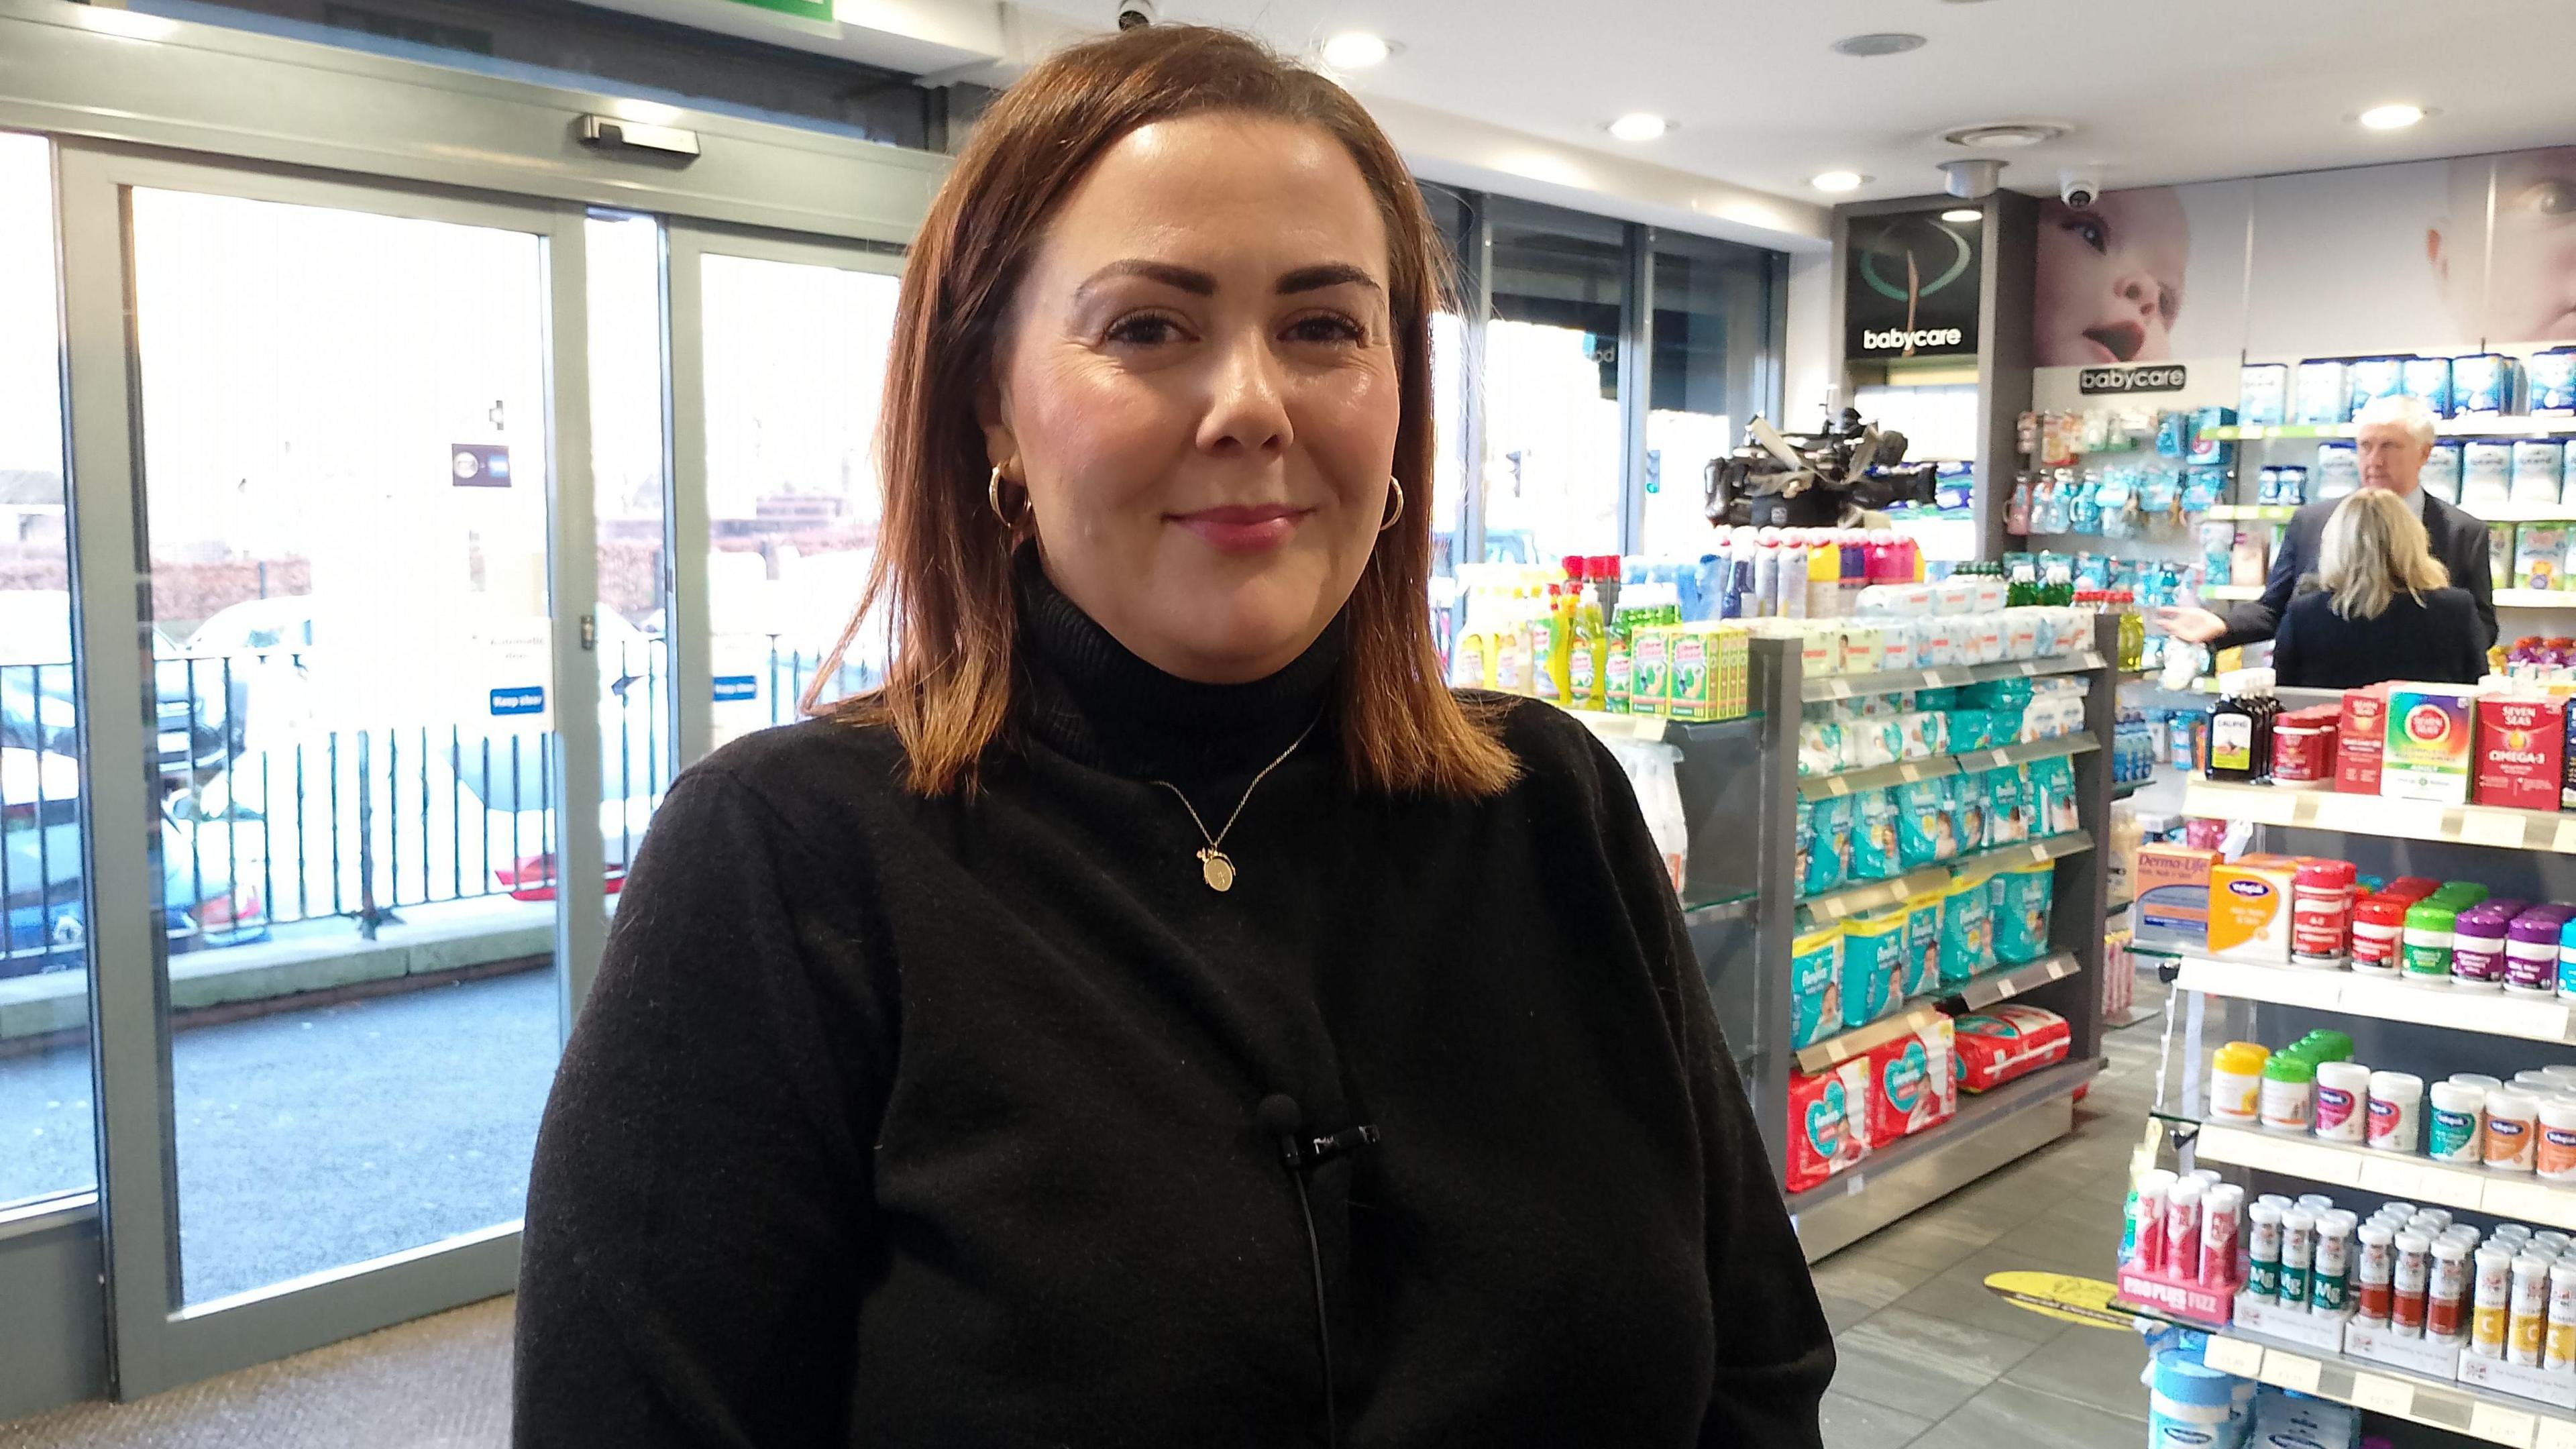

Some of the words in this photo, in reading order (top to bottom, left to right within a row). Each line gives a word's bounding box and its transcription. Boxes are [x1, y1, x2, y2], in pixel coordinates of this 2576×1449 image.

[1864, 328, 1962, 351] babycare
[2082, 369, 2185, 390] babycare
[2502, 706, 2536, 718] SEVEN
[2504, 715, 2532, 727] SEAS
[2489, 749, 2545, 764] OMEGA-3
[2250, 1265, 2275, 1289] Mg
[2315, 1279, 2341, 1303] Mg
[2481, 1316, 2494, 1333] C
[2527, 1324, 2539, 1340] C
